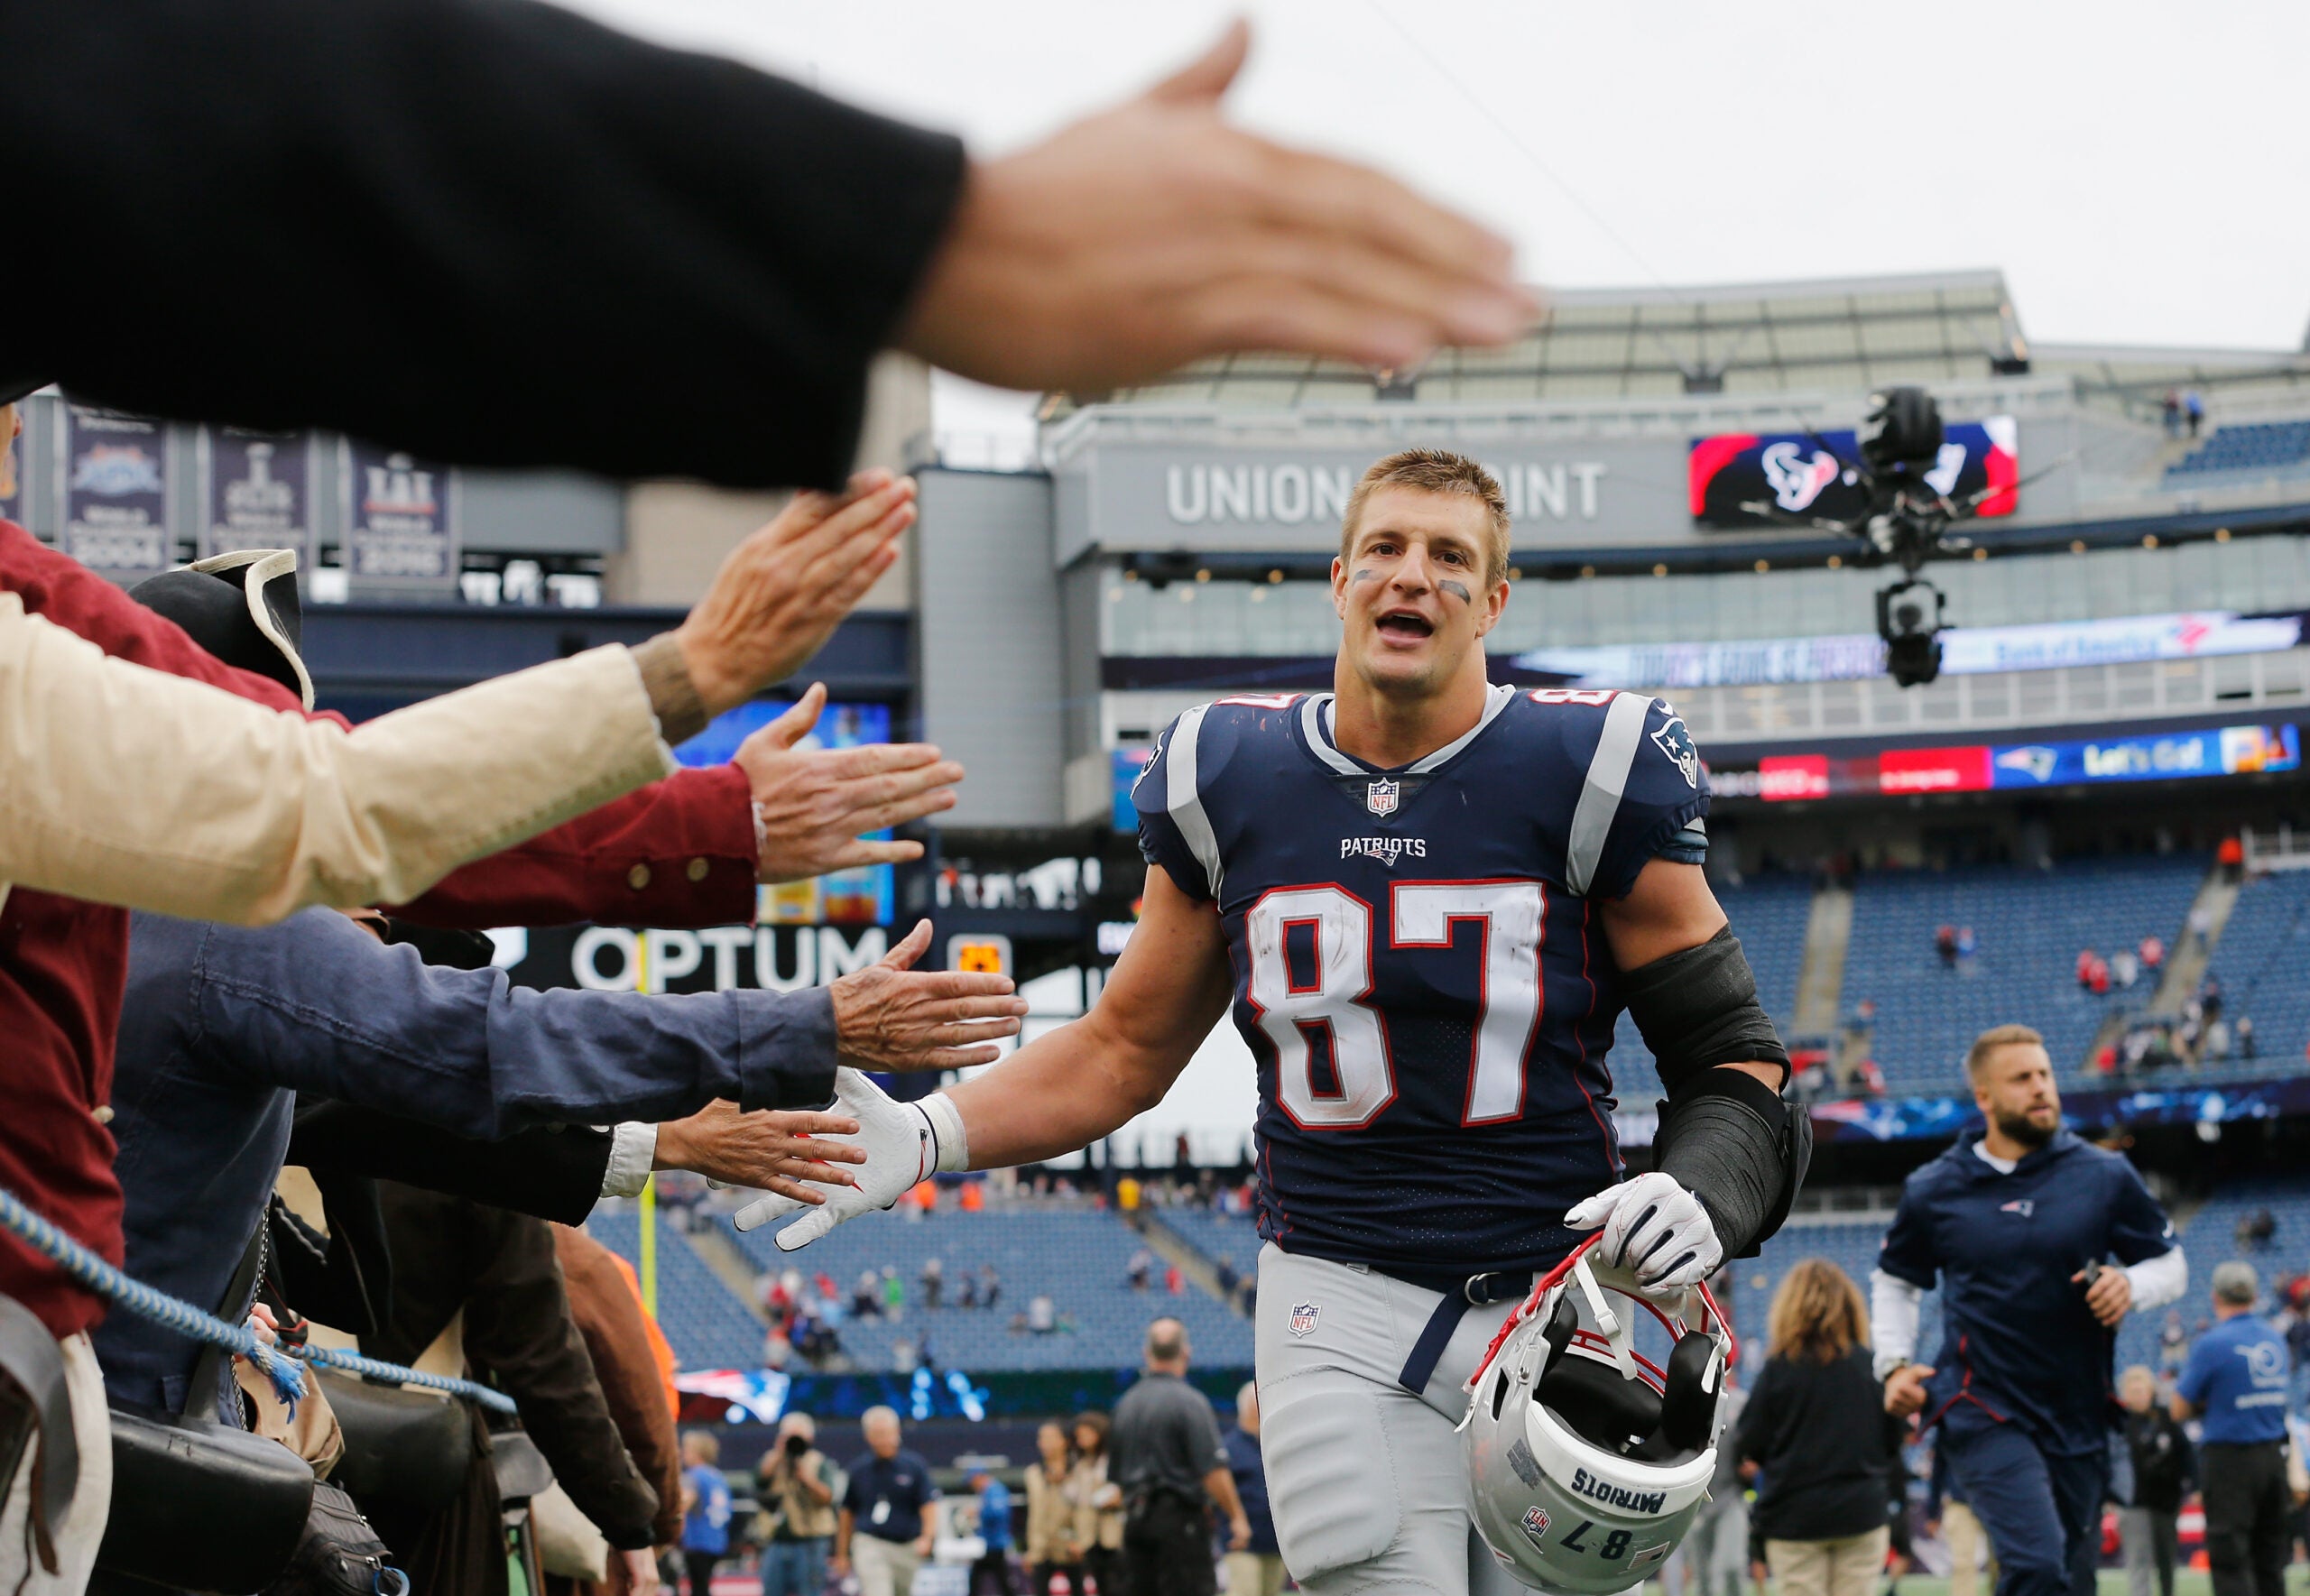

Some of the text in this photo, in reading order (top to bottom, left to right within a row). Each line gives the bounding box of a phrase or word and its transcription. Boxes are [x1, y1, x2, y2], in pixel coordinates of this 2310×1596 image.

[1168, 463, 1354, 524] UNION
[1372, 795, 1394, 810] NFL
[1341, 837, 1426, 860] PATRIOTS
[571, 926, 887, 993] OPTUM
[1243, 879, 1547, 1131] 87
[1292, 1316, 1313, 1331] NFL
[1571, 1467, 1668, 1515] PATRIOTS
